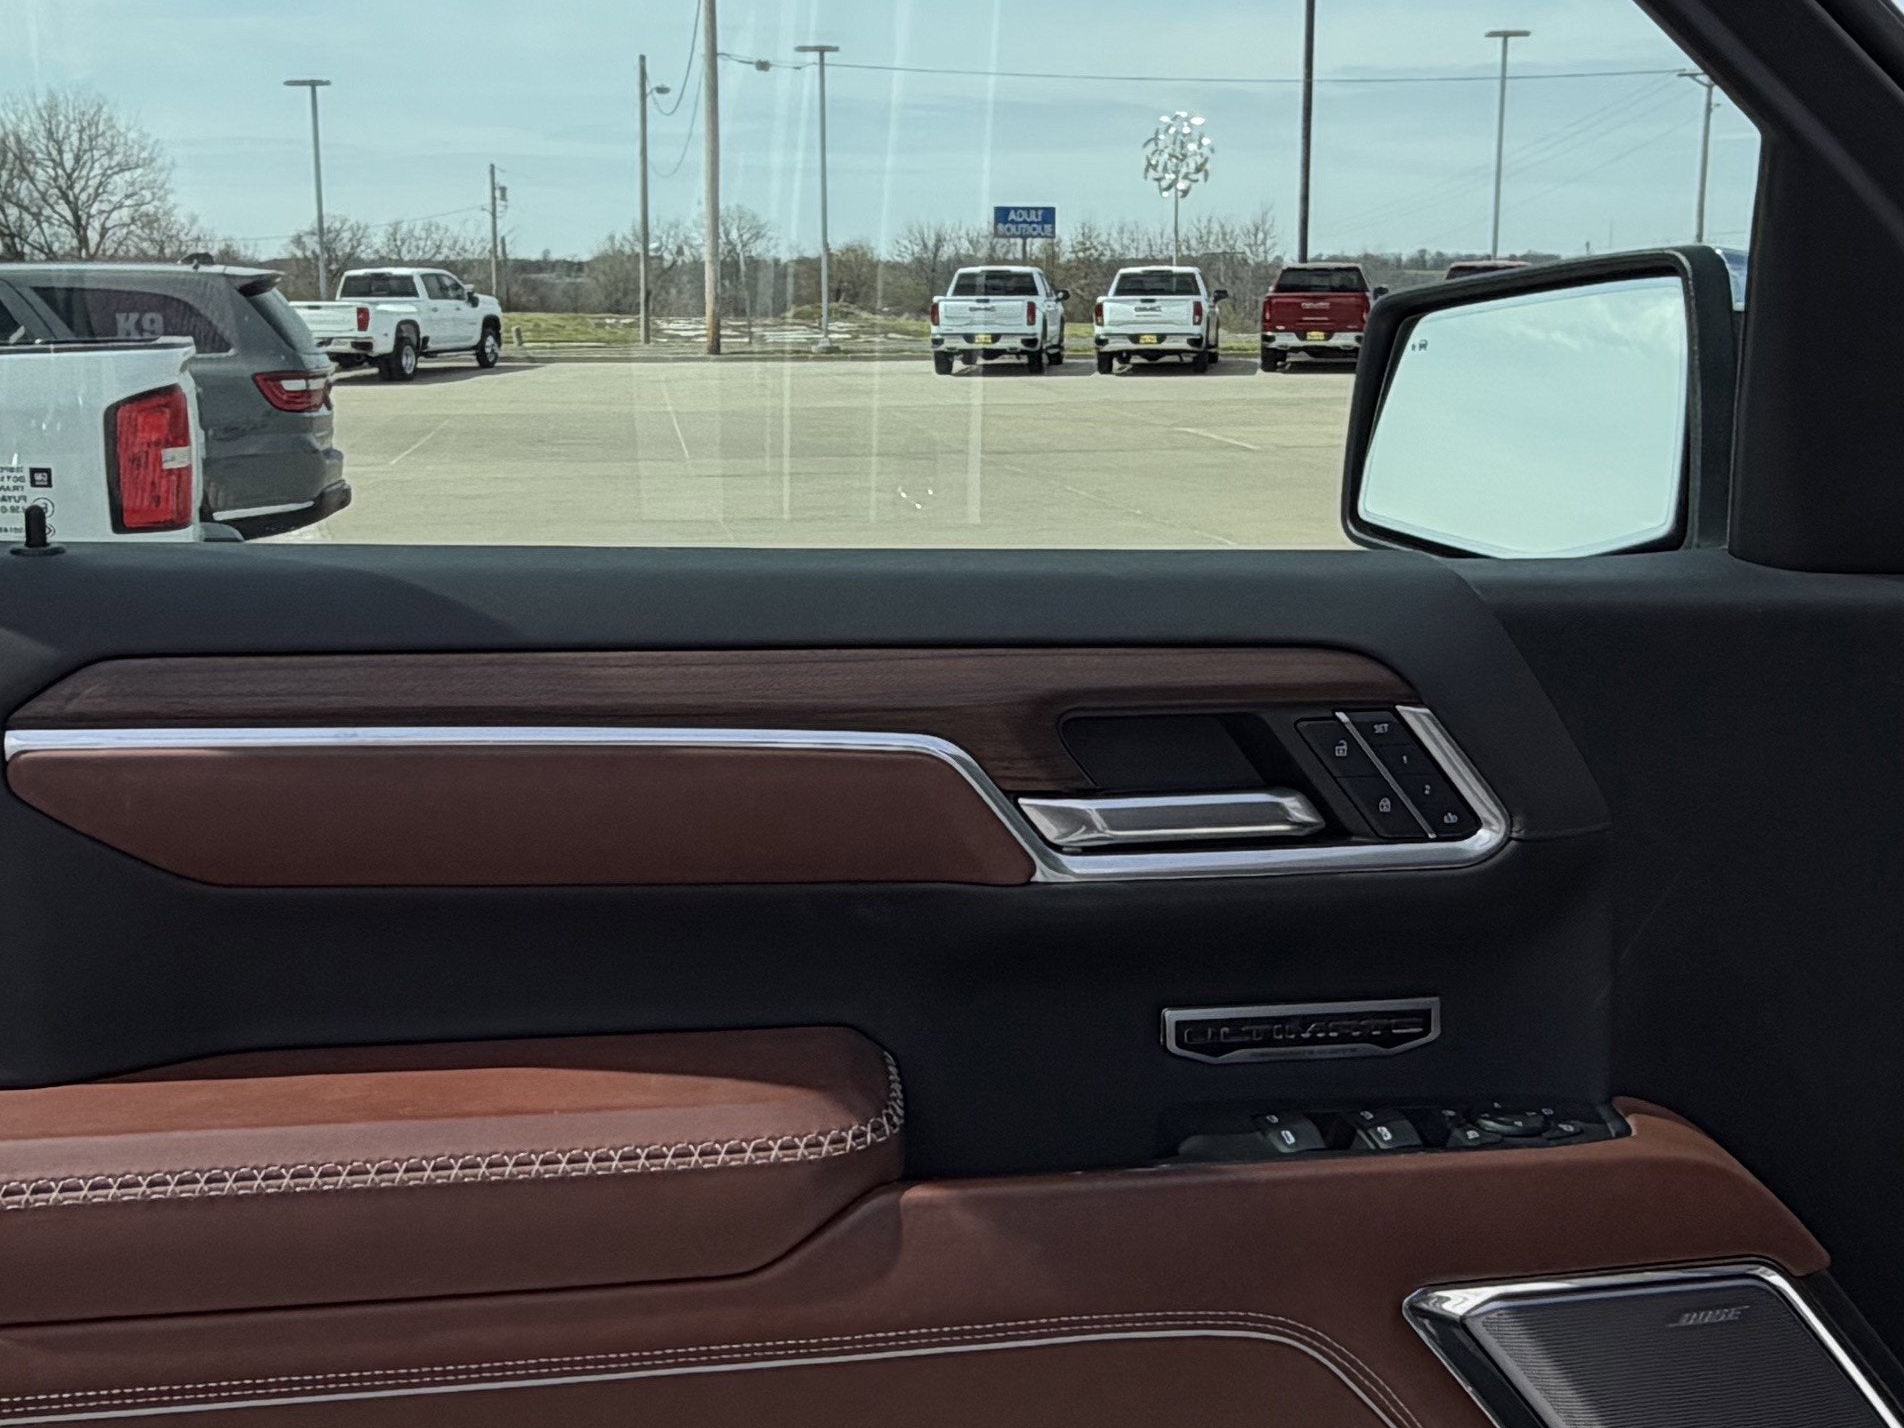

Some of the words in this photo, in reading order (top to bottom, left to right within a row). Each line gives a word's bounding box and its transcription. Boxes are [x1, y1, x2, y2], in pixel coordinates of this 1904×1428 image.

[1008, 209, 1043, 222] ADULT
[115, 312, 164, 339] K9
[1668, 1305, 1749, 1327] BOSE
